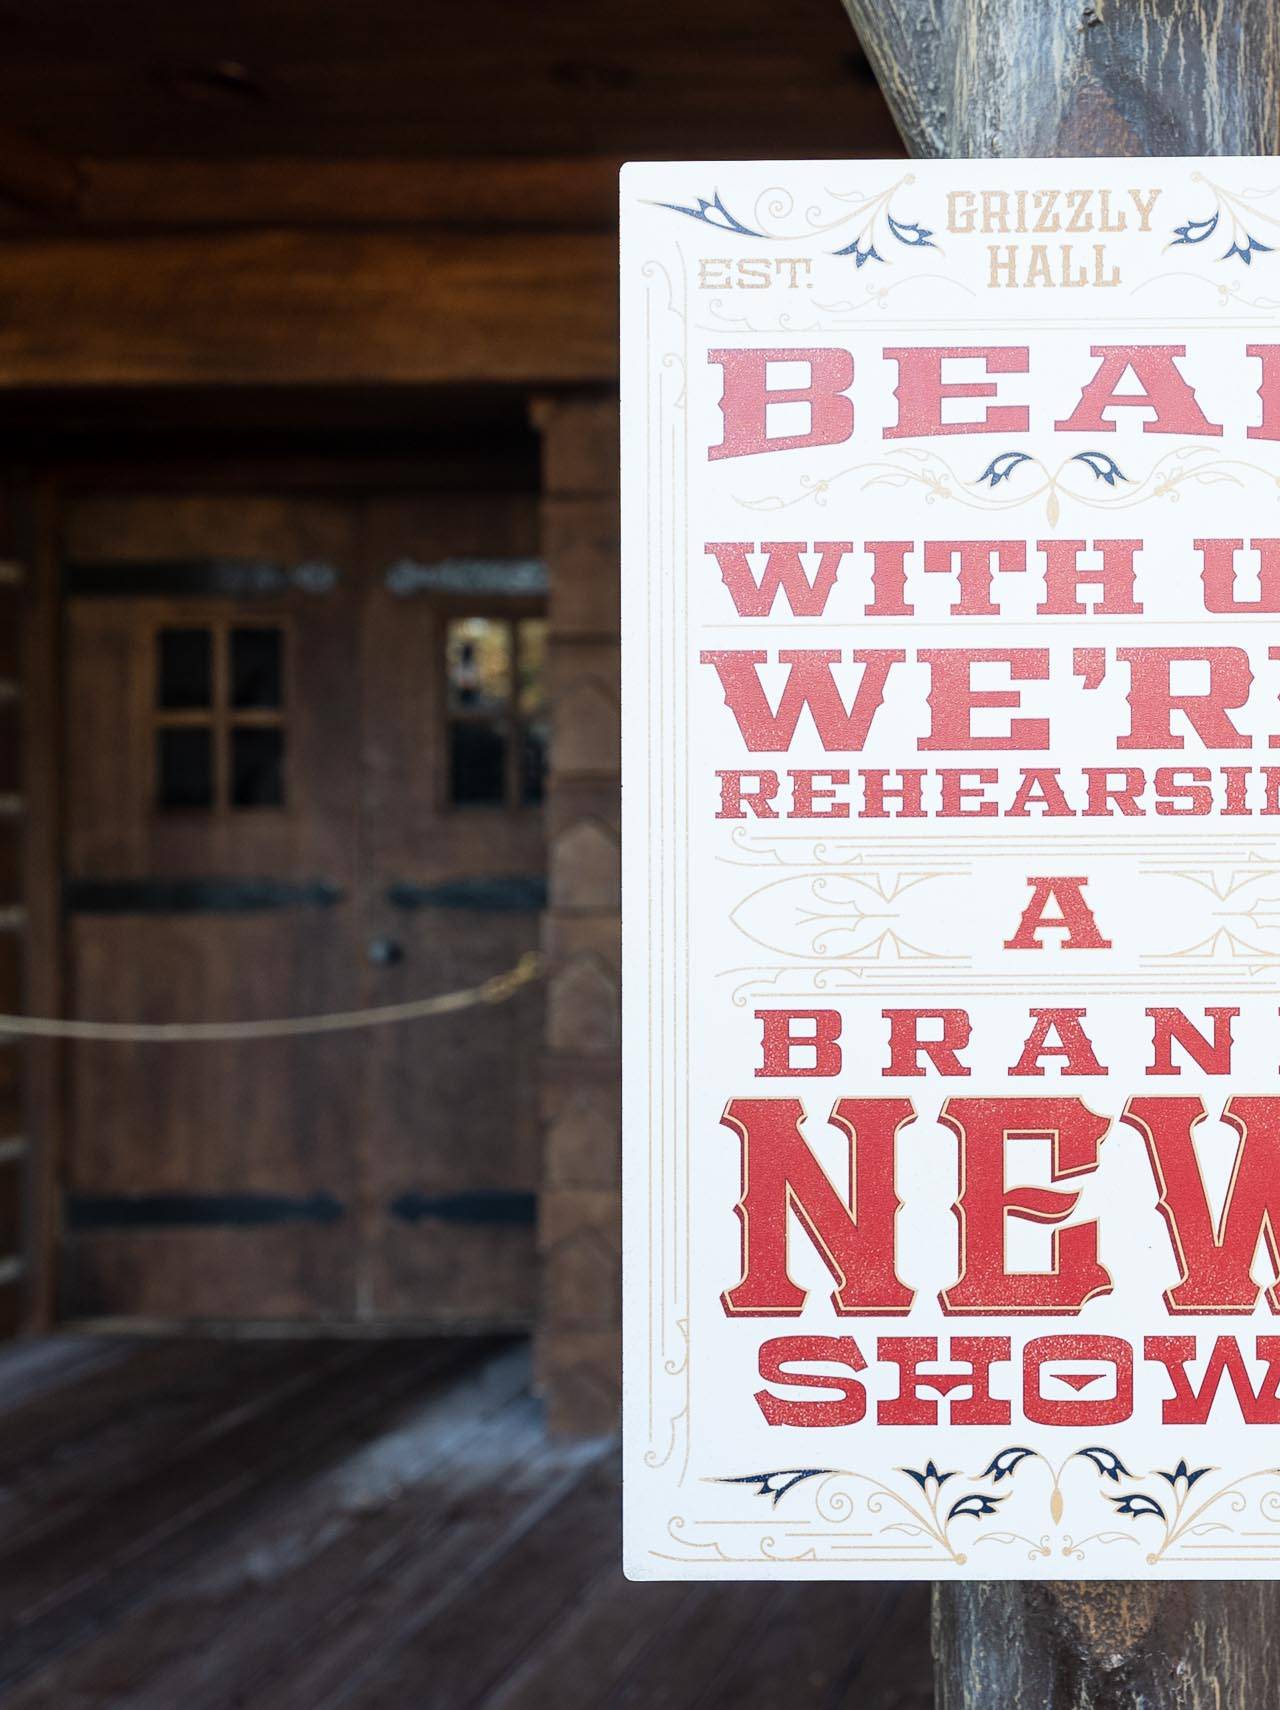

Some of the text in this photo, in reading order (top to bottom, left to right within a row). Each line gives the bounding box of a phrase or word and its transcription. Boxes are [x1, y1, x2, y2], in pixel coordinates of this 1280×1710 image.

[946, 188, 1164, 236] GRIZZLY
[697, 258, 814, 290] EST.
[986, 244, 1123, 289] HALL
[703, 538, 1145, 617] WITH
[1003, 876, 1113, 950] A
